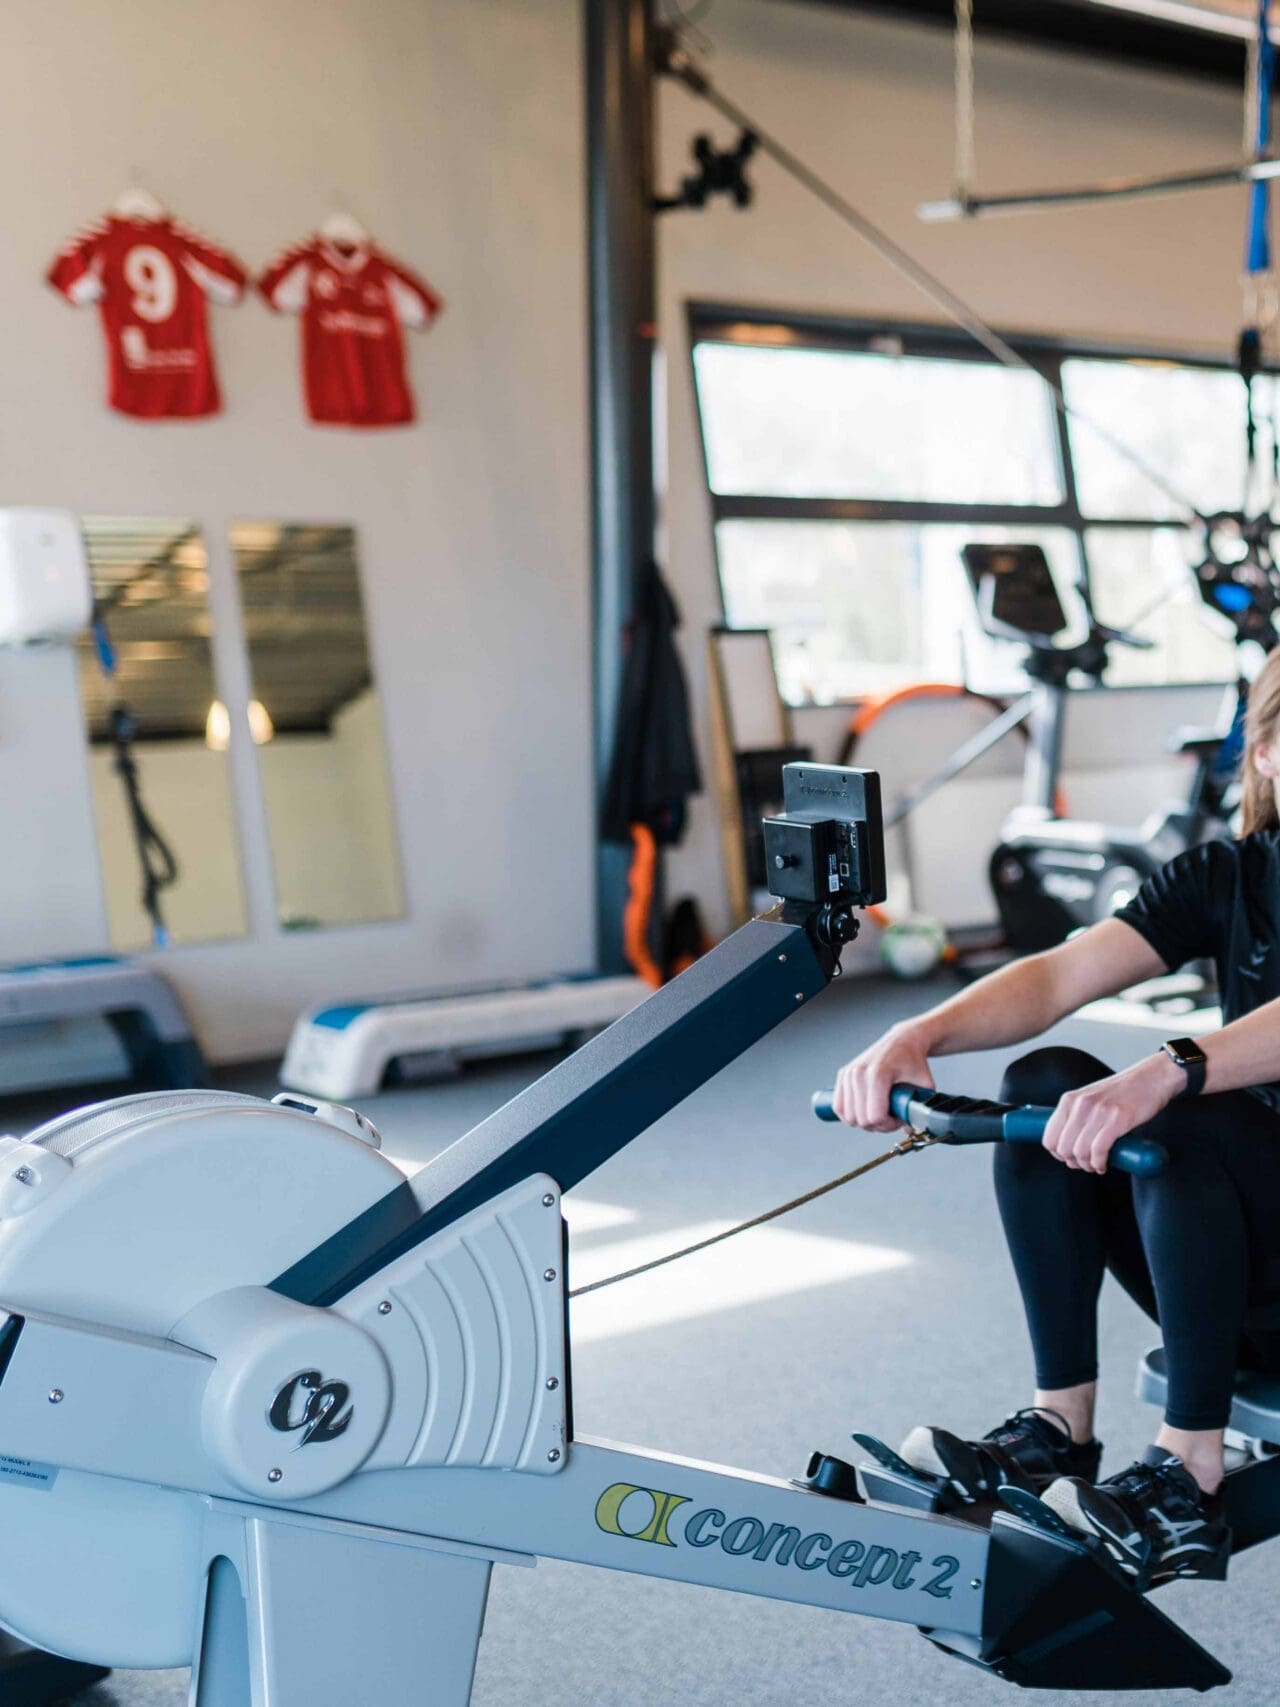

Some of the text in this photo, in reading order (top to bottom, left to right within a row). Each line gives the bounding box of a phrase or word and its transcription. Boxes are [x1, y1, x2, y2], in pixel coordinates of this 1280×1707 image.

[124, 244, 178, 323] 9
[684, 1508, 960, 1599] concept 2
